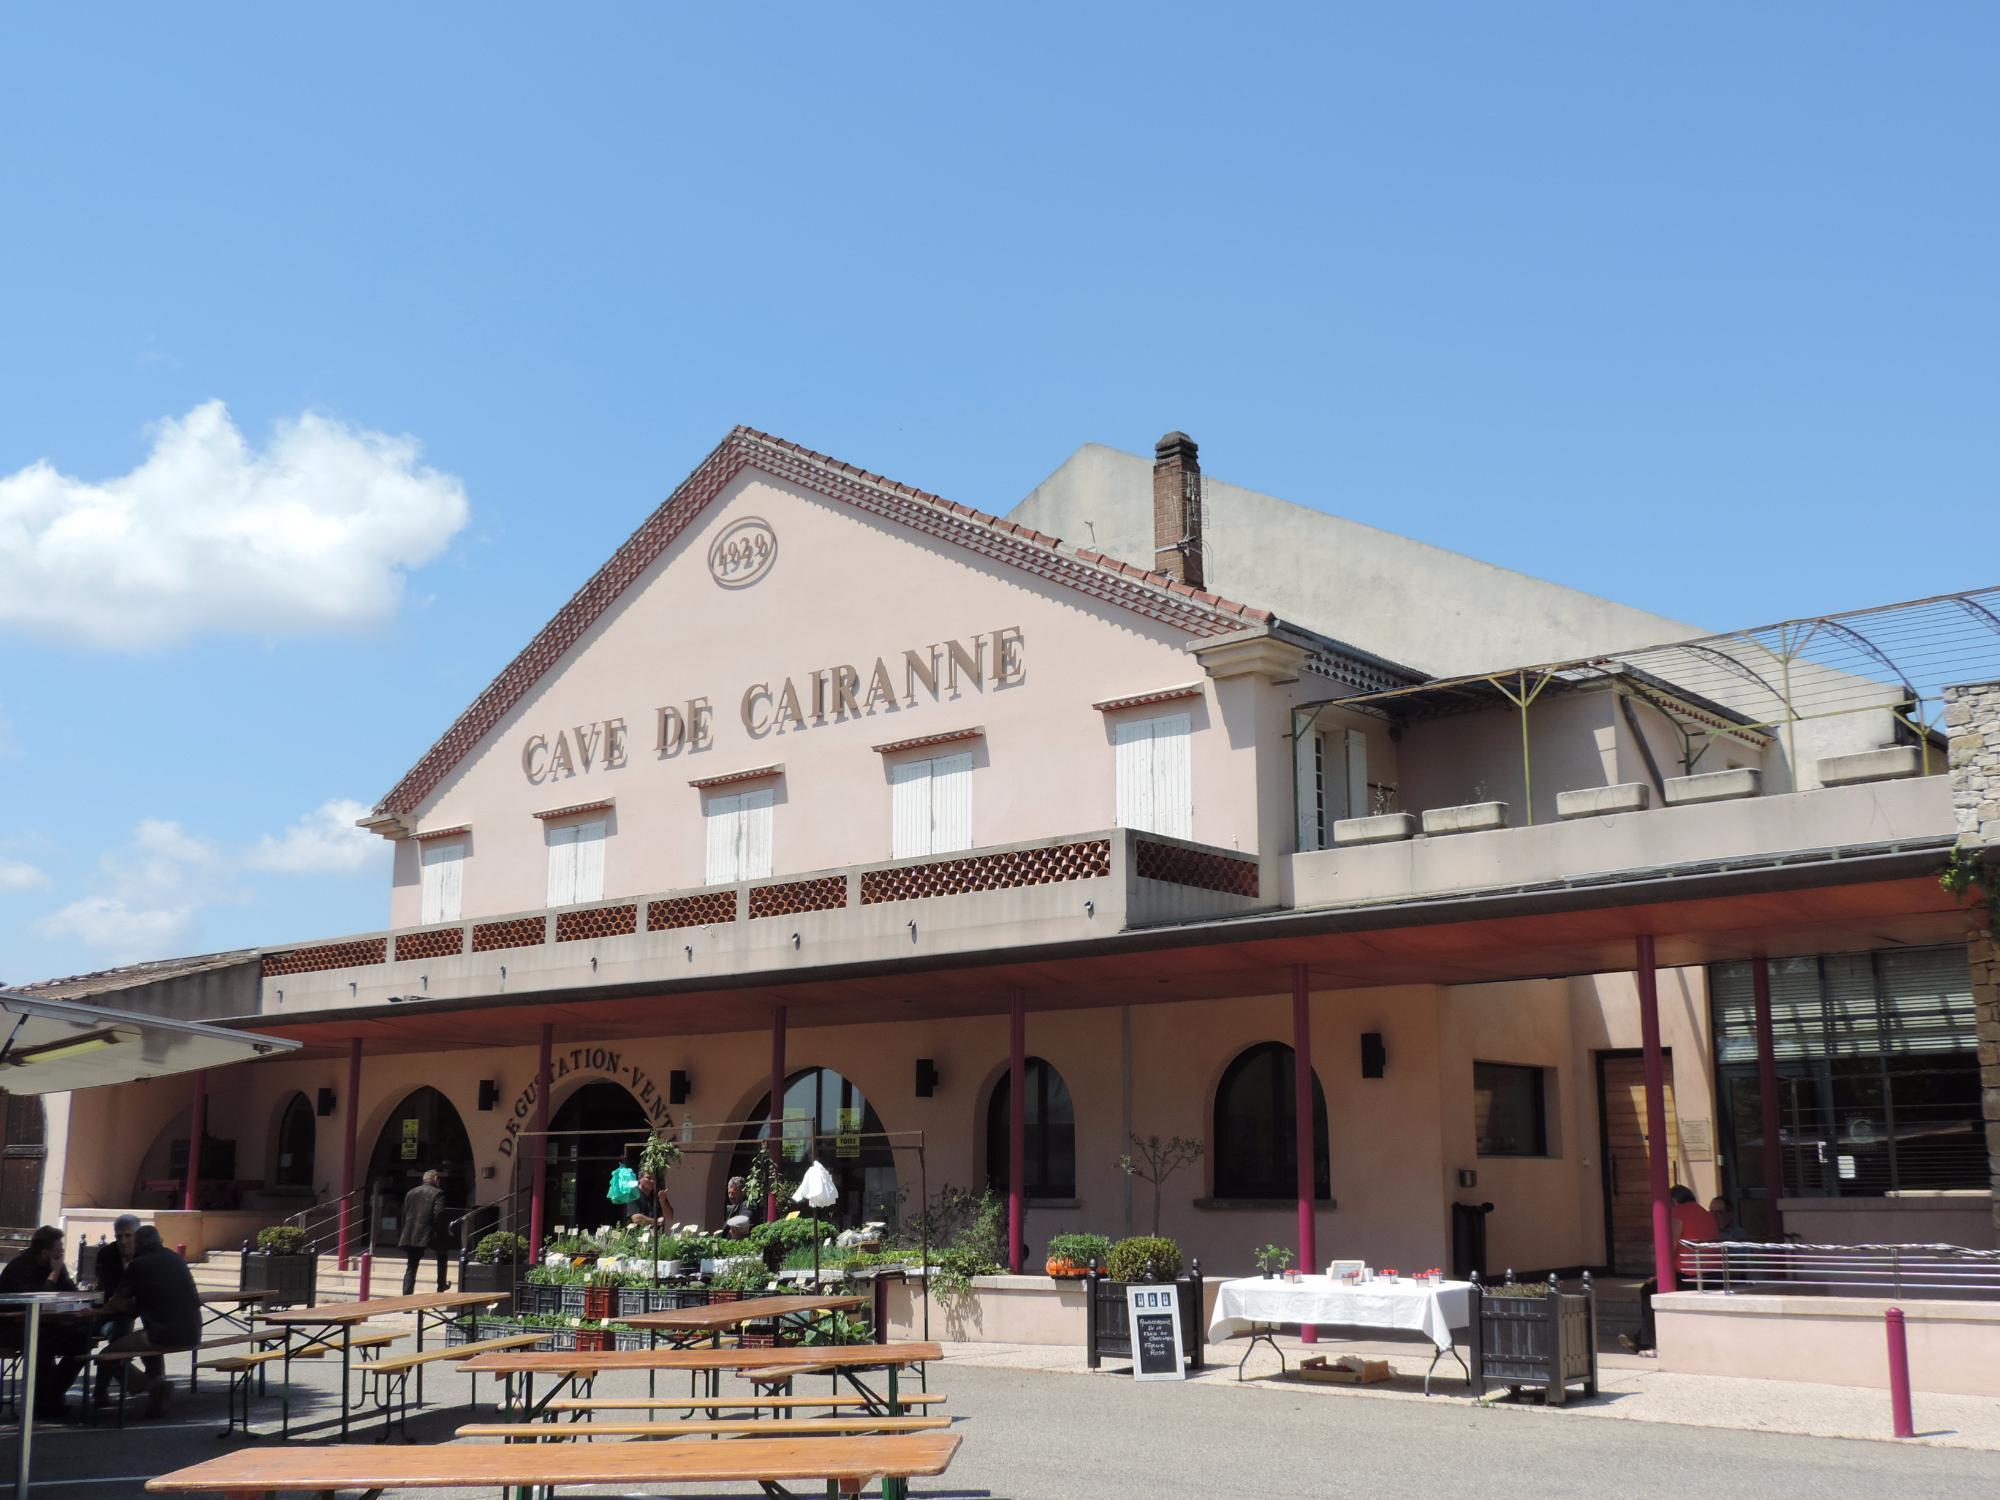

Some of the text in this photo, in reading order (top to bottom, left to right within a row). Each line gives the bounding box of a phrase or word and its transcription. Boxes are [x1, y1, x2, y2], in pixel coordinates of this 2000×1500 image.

[718, 533, 766, 567] 1929
[521, 625, 1022, 778] CAVE DE CAIRANNE
